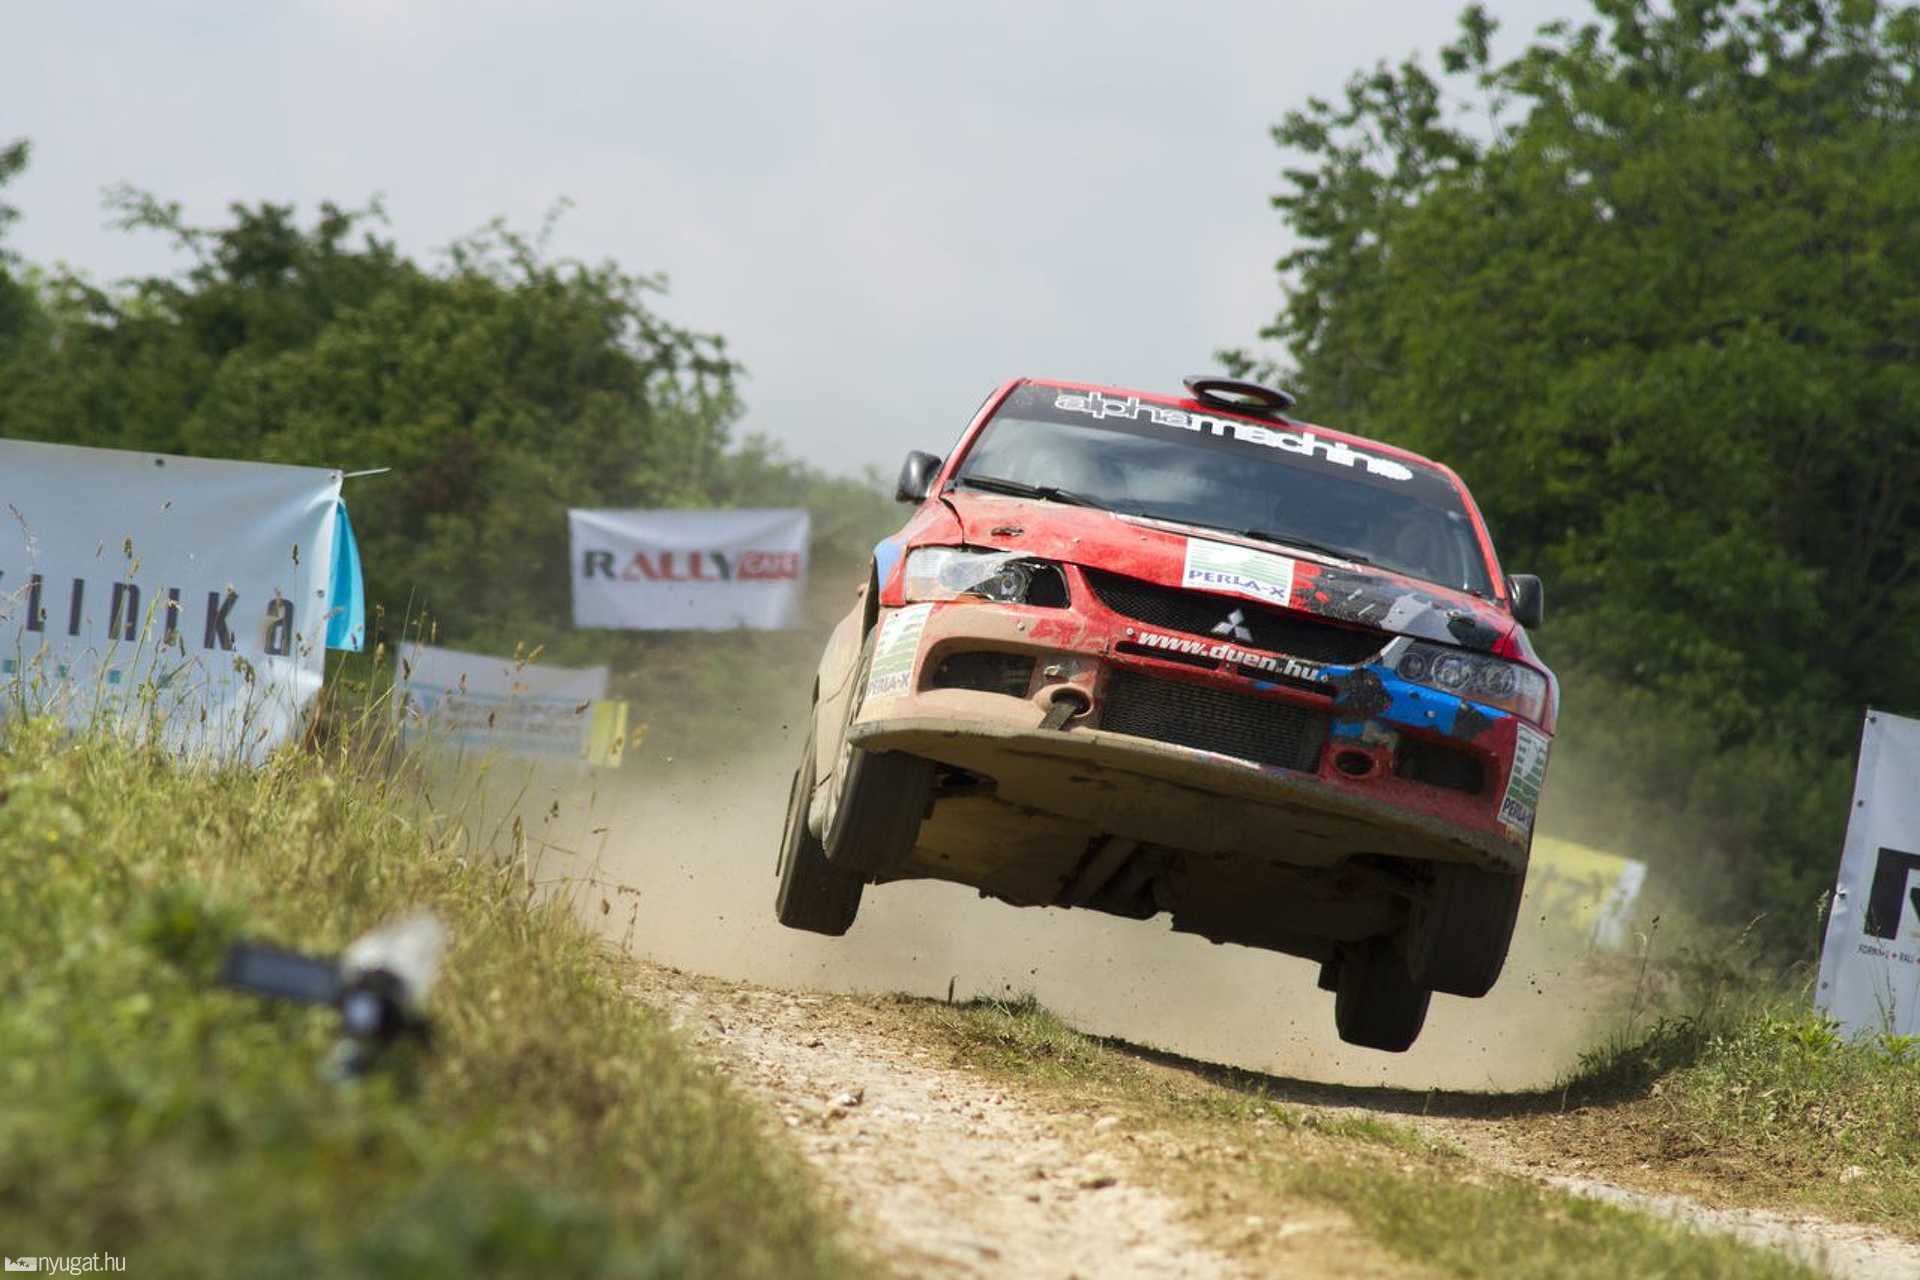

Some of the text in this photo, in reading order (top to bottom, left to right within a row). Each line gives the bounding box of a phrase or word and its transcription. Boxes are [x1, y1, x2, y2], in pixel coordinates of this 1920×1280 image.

[582, 550, 735, 582] RALLY
[1188, 569, 1286, 599] PERLA-X
[1136, 631, 1321, 682] www.duen.hu
